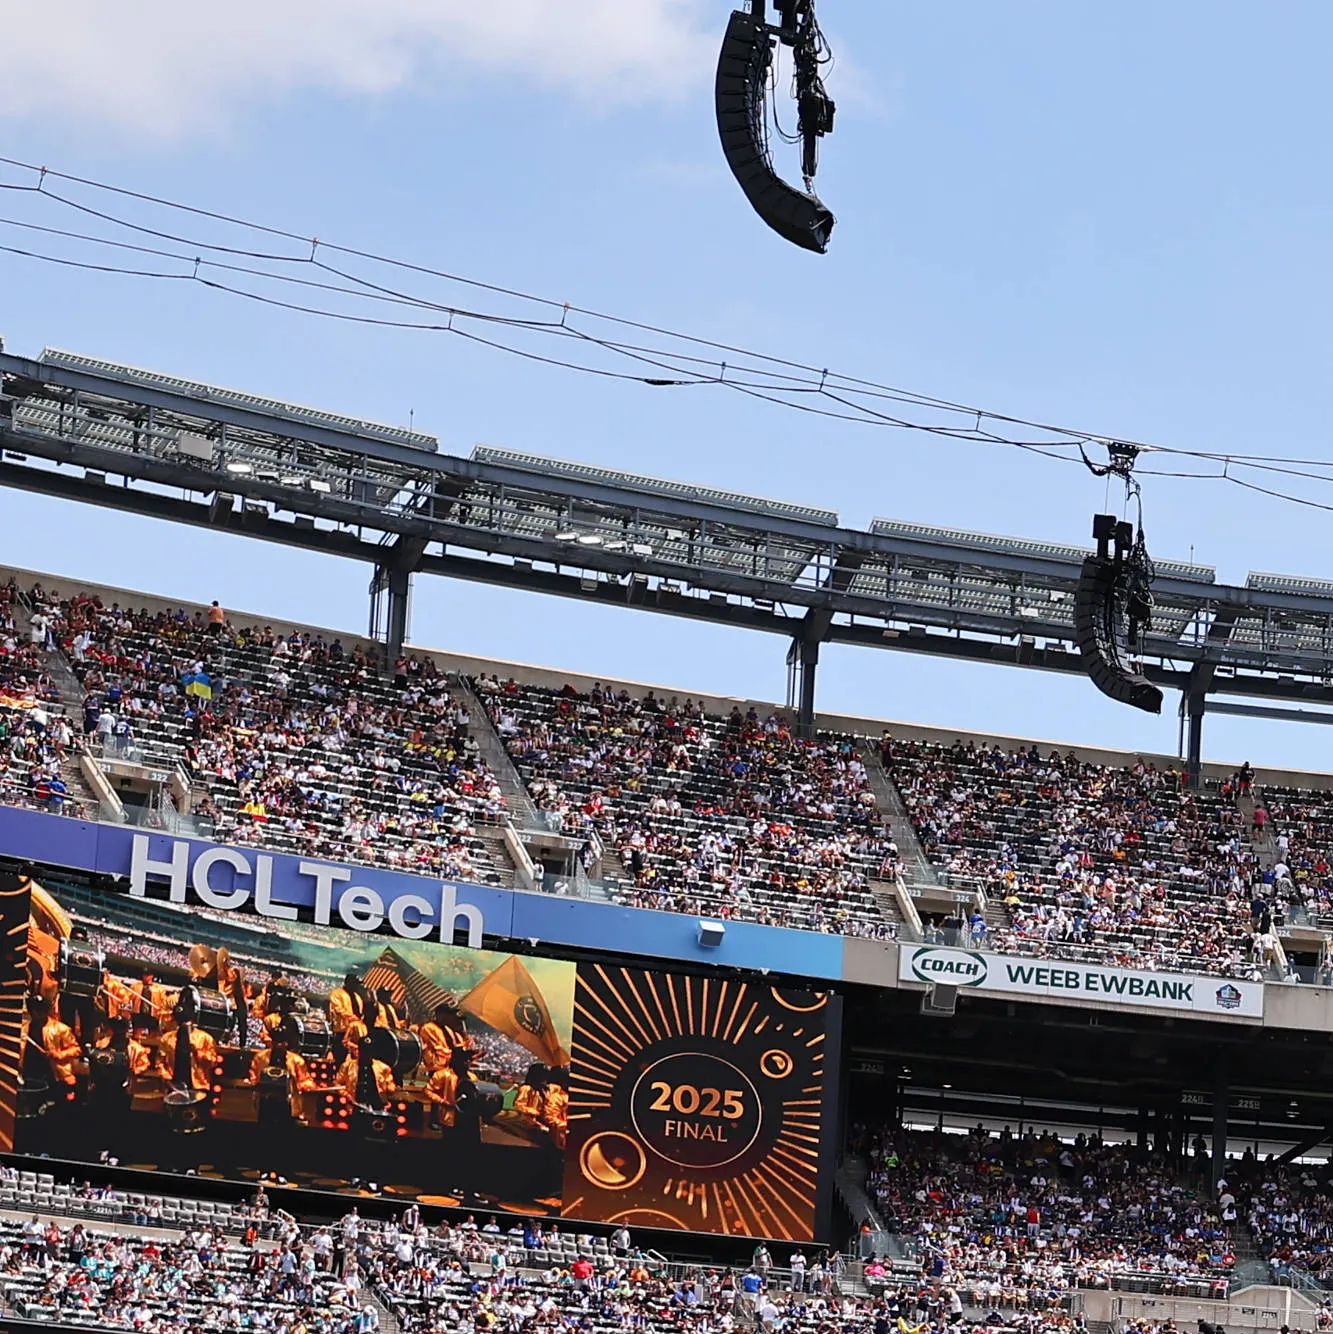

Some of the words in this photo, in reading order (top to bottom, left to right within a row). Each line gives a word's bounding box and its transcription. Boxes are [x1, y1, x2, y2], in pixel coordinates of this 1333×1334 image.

[129, 833, 485, 948] HCLTech
[920, 957, 979, 977] COACH
[1006, 963, 1080, 991] WEEB
[1084, 972, 1194, 1002] EWBANK
[649, 1081, 745, 1120] 2025
[664, 1119, 728, 1143] FINAL
